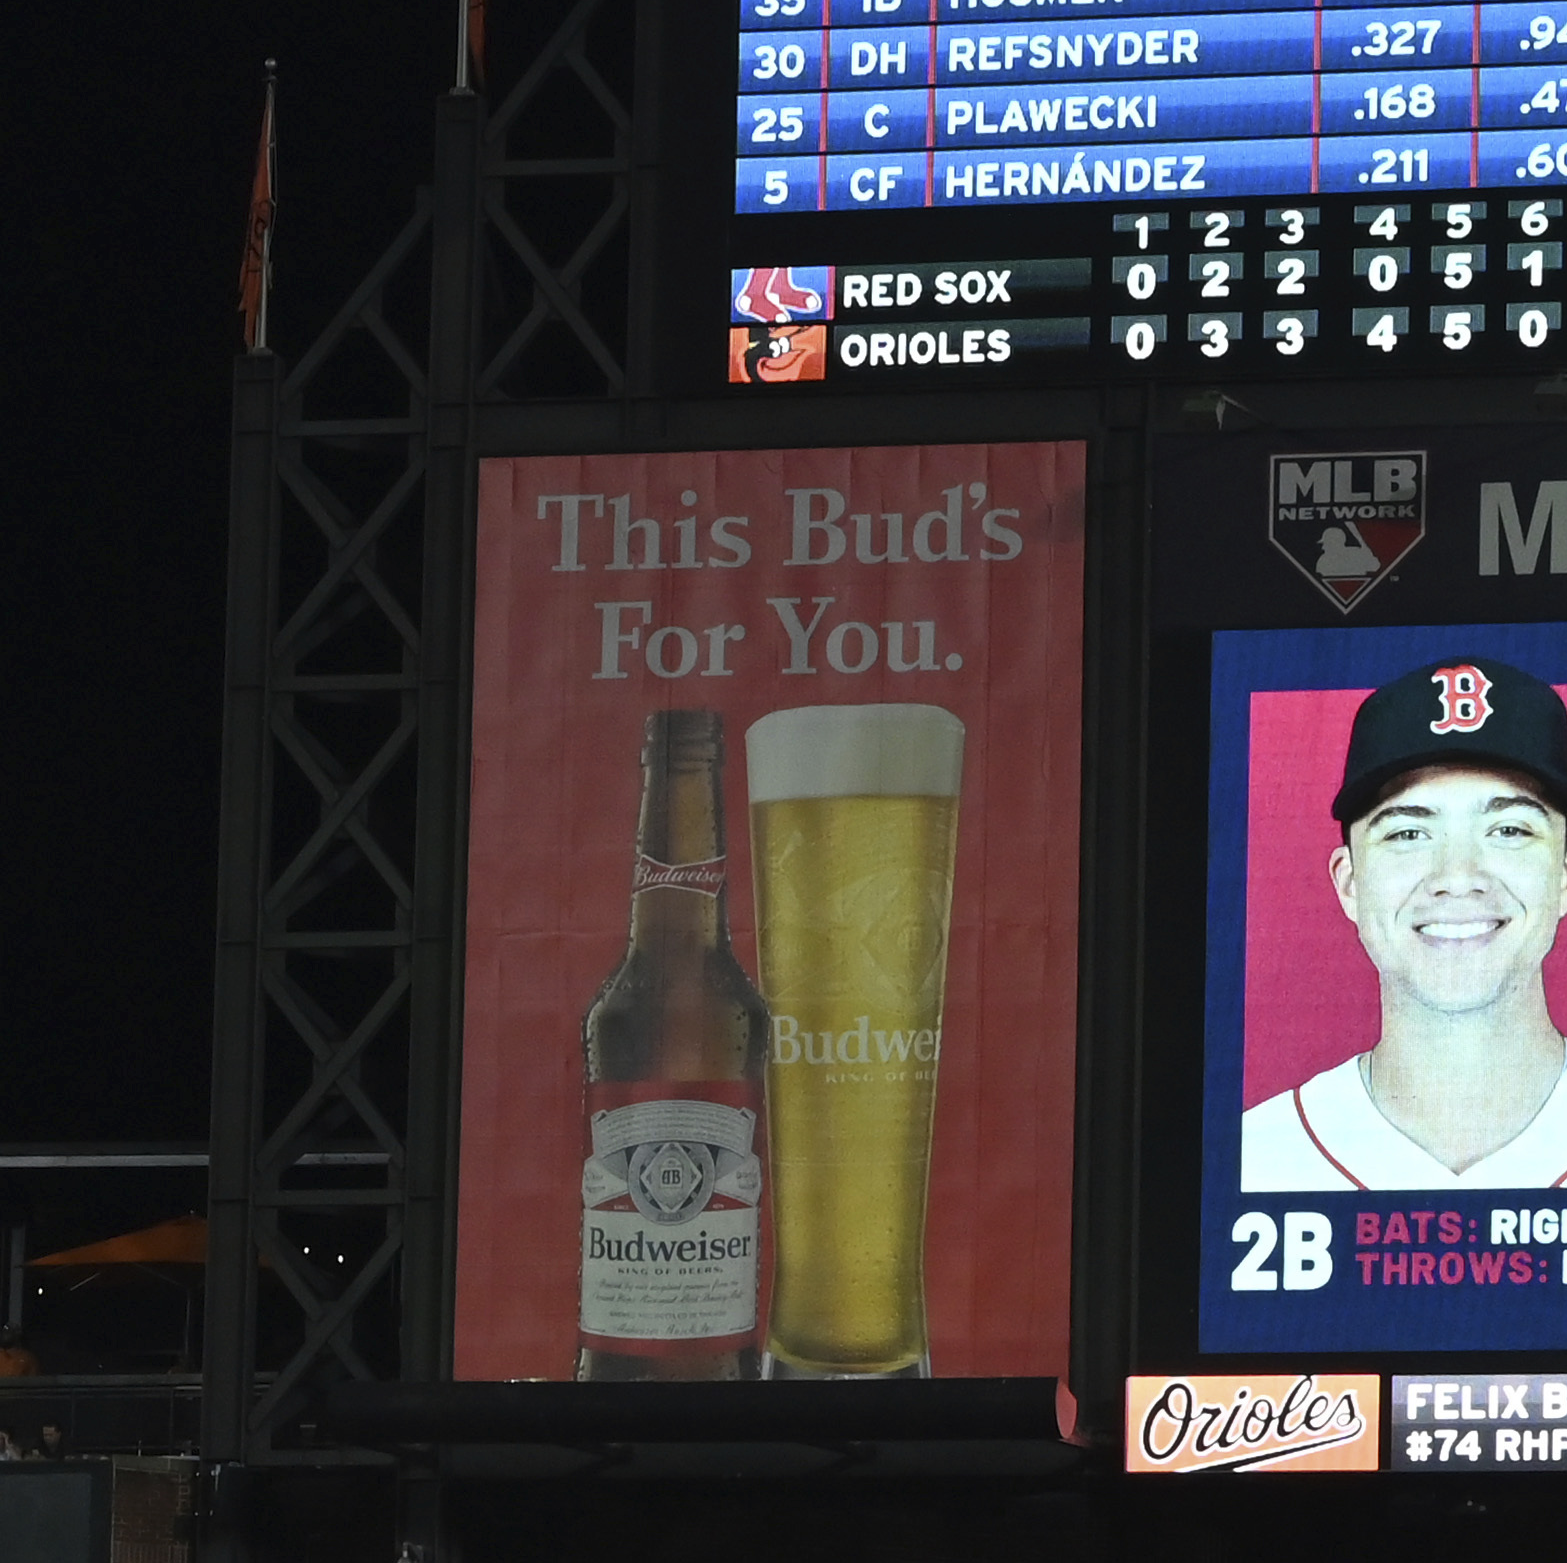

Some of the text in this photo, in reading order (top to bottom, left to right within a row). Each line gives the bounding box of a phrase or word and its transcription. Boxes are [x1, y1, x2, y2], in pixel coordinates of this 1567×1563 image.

[948, 28, 1199, 72] REFSNYDER
[947, 94, 1157, 135] PLAWECKI
[945, 151, 1206, 199] HERNÁNDEZ
[843, 272, 923, 308] RED
[934, 270, 1012, 305] SOX
[840, 329, 1011, 367] ORIOLES
[1280, 459, 1419, 503] MLB
[537, 482, 1023, 573] This Bud's
[1277, 504, 1417, 522] NETWORK
[592, 596, 963, 680] For You.
[1430, 664, 1493, 733] B
[589, 1226, 752, 1262] Budweiser
[1356, 1213, 1478, 1244] BATS:
[1231, 1211, 1333, 1291] 2B
[1356, 1251, 1549, 1285] THROWS:
[1406, 1378, 1529, 1420] FELIX
[1141, 1377, 1364, 1472] Orioles
[1405, 1429, 1482, 1462] #74
